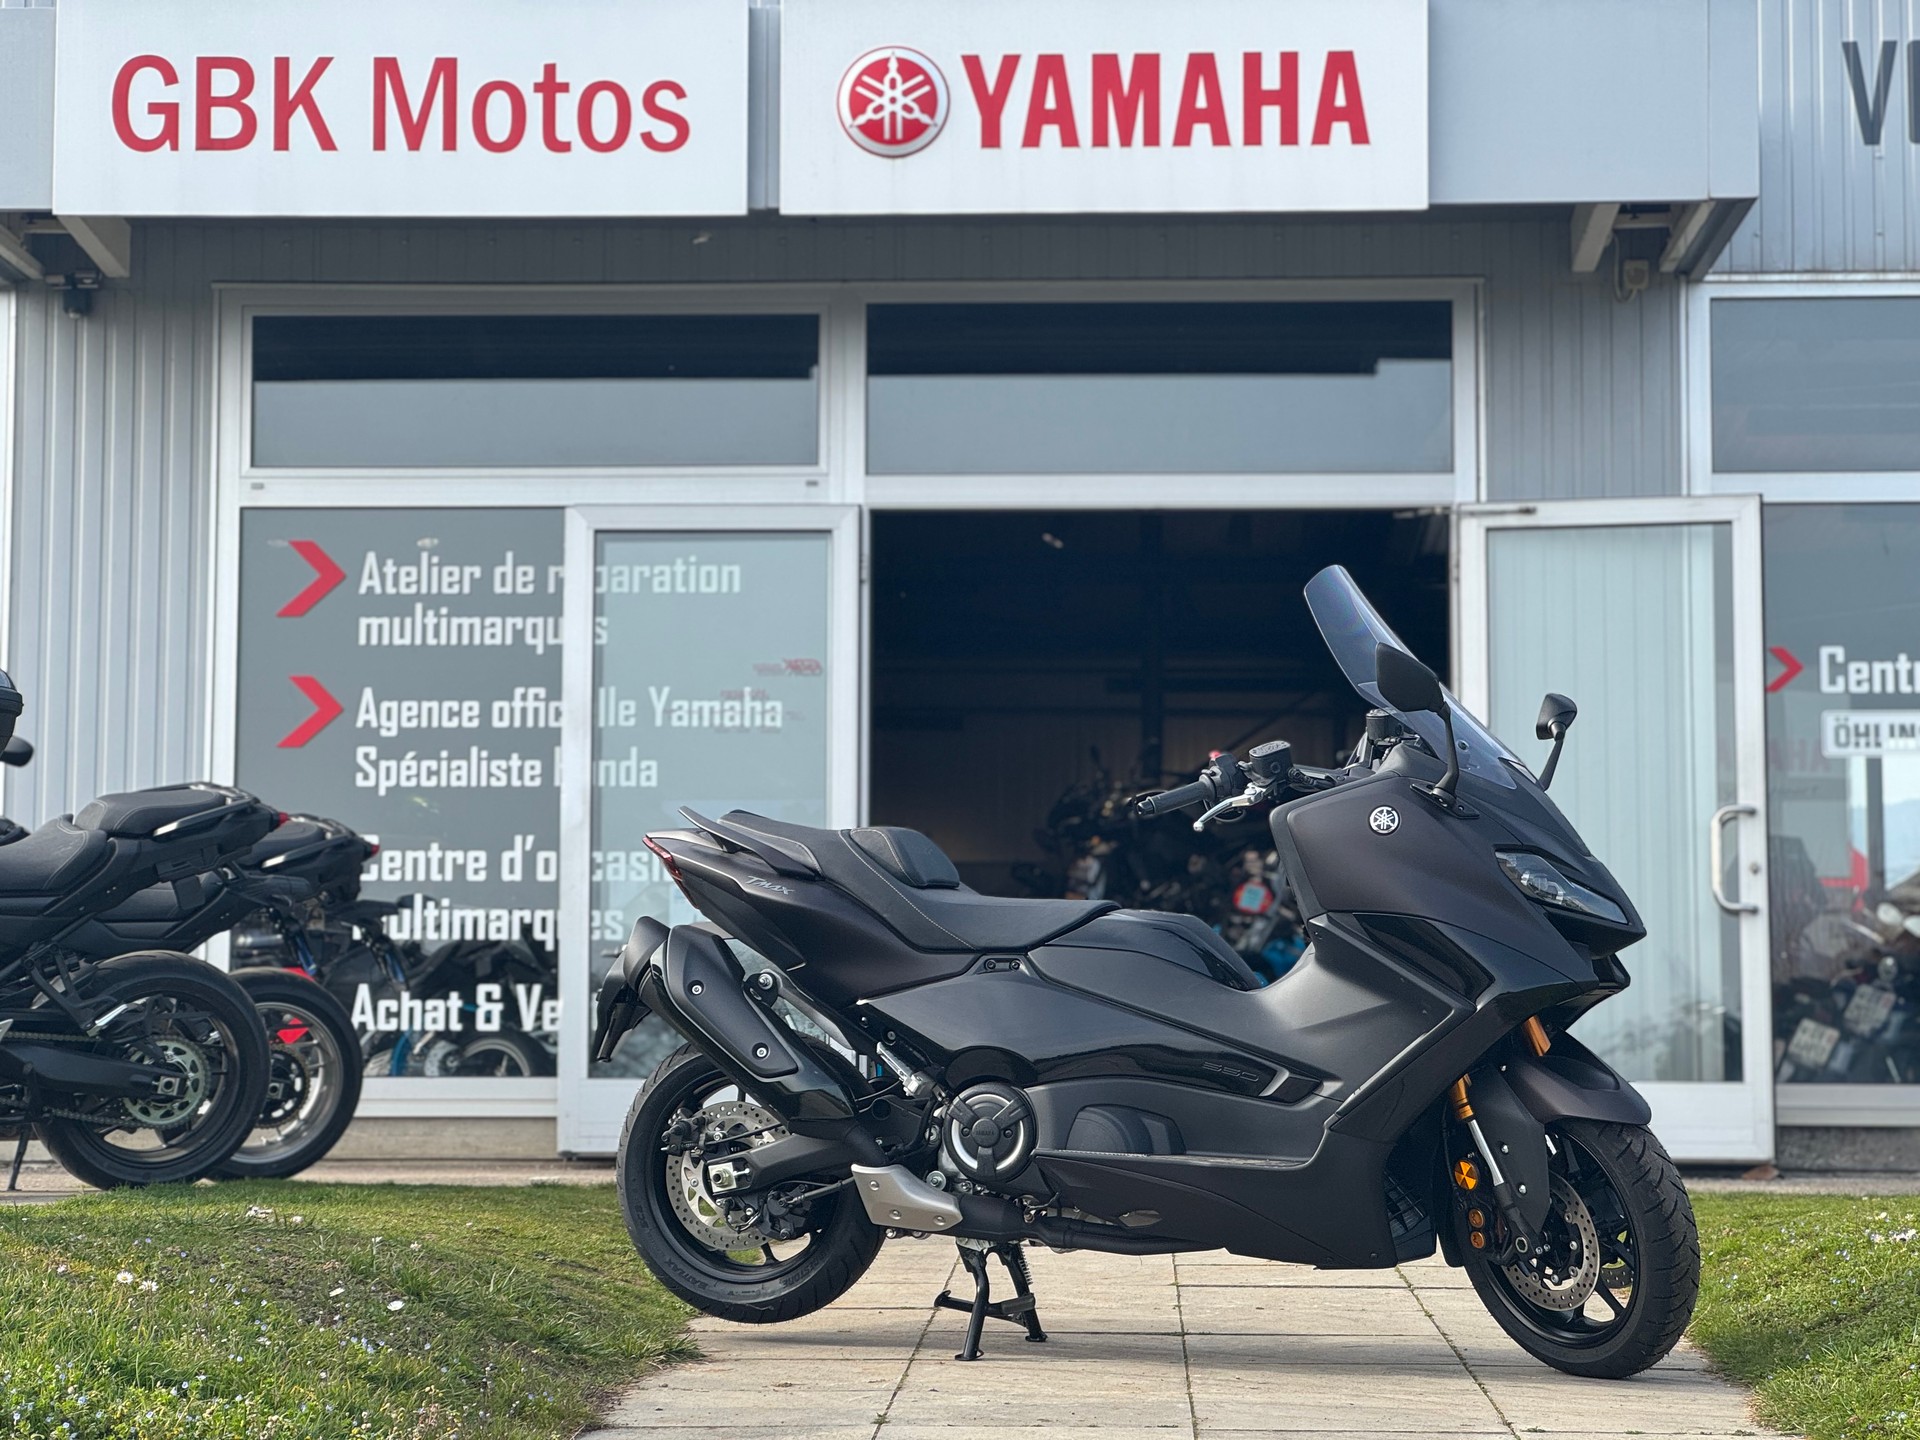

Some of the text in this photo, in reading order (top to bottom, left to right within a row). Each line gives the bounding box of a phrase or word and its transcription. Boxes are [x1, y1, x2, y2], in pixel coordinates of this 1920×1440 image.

[111, 54, 691, 153] GBK Motos
[960, 50, 1370, 149] YAMAHA
[358, 551, 741, 595] Atelier de rparation
[358, 603, 608, 655] multimarqus
[355, 686, 783, 738] Agence officlle Yamaha
[1834, 716, 1920, 749] ÖHLIN
[355, 746, 658, 797] Spécialiste nda
[351, 983, 463, 1032] Achat
[476, 983, 504, 1032] &
